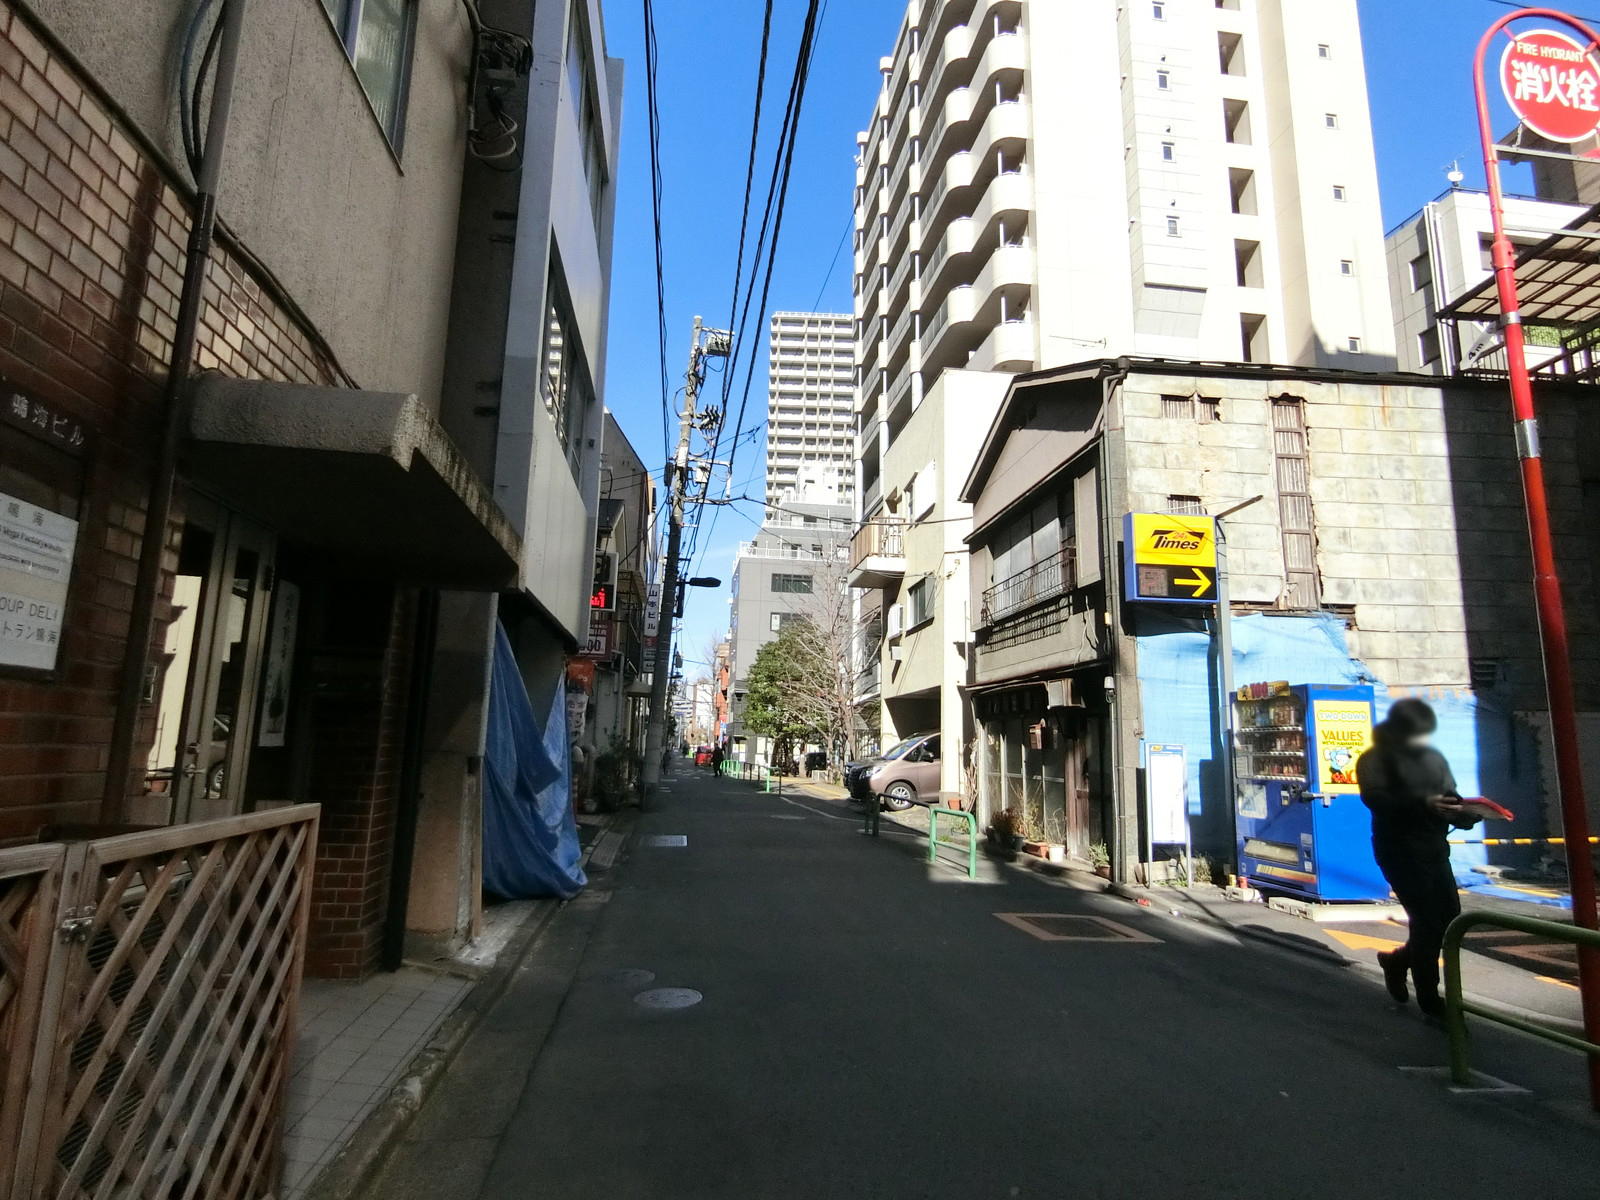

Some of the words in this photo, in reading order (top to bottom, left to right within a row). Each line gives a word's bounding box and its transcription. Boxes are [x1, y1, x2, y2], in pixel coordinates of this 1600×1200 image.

[1517, 42, 1538, 56] FIRE
[1540, 46, 1584, 63] HYDRANT
[1511, 60, 1599, 111] 消火栓
[12, 393, 84, 446] 鳴海ビル
[1153, 536, 1200, 550] Times
[29, 603, 59, 621] DELI
[1341, 713, 1367, 721] DOWN
[1321, 730, 1364, 741] VALUES
